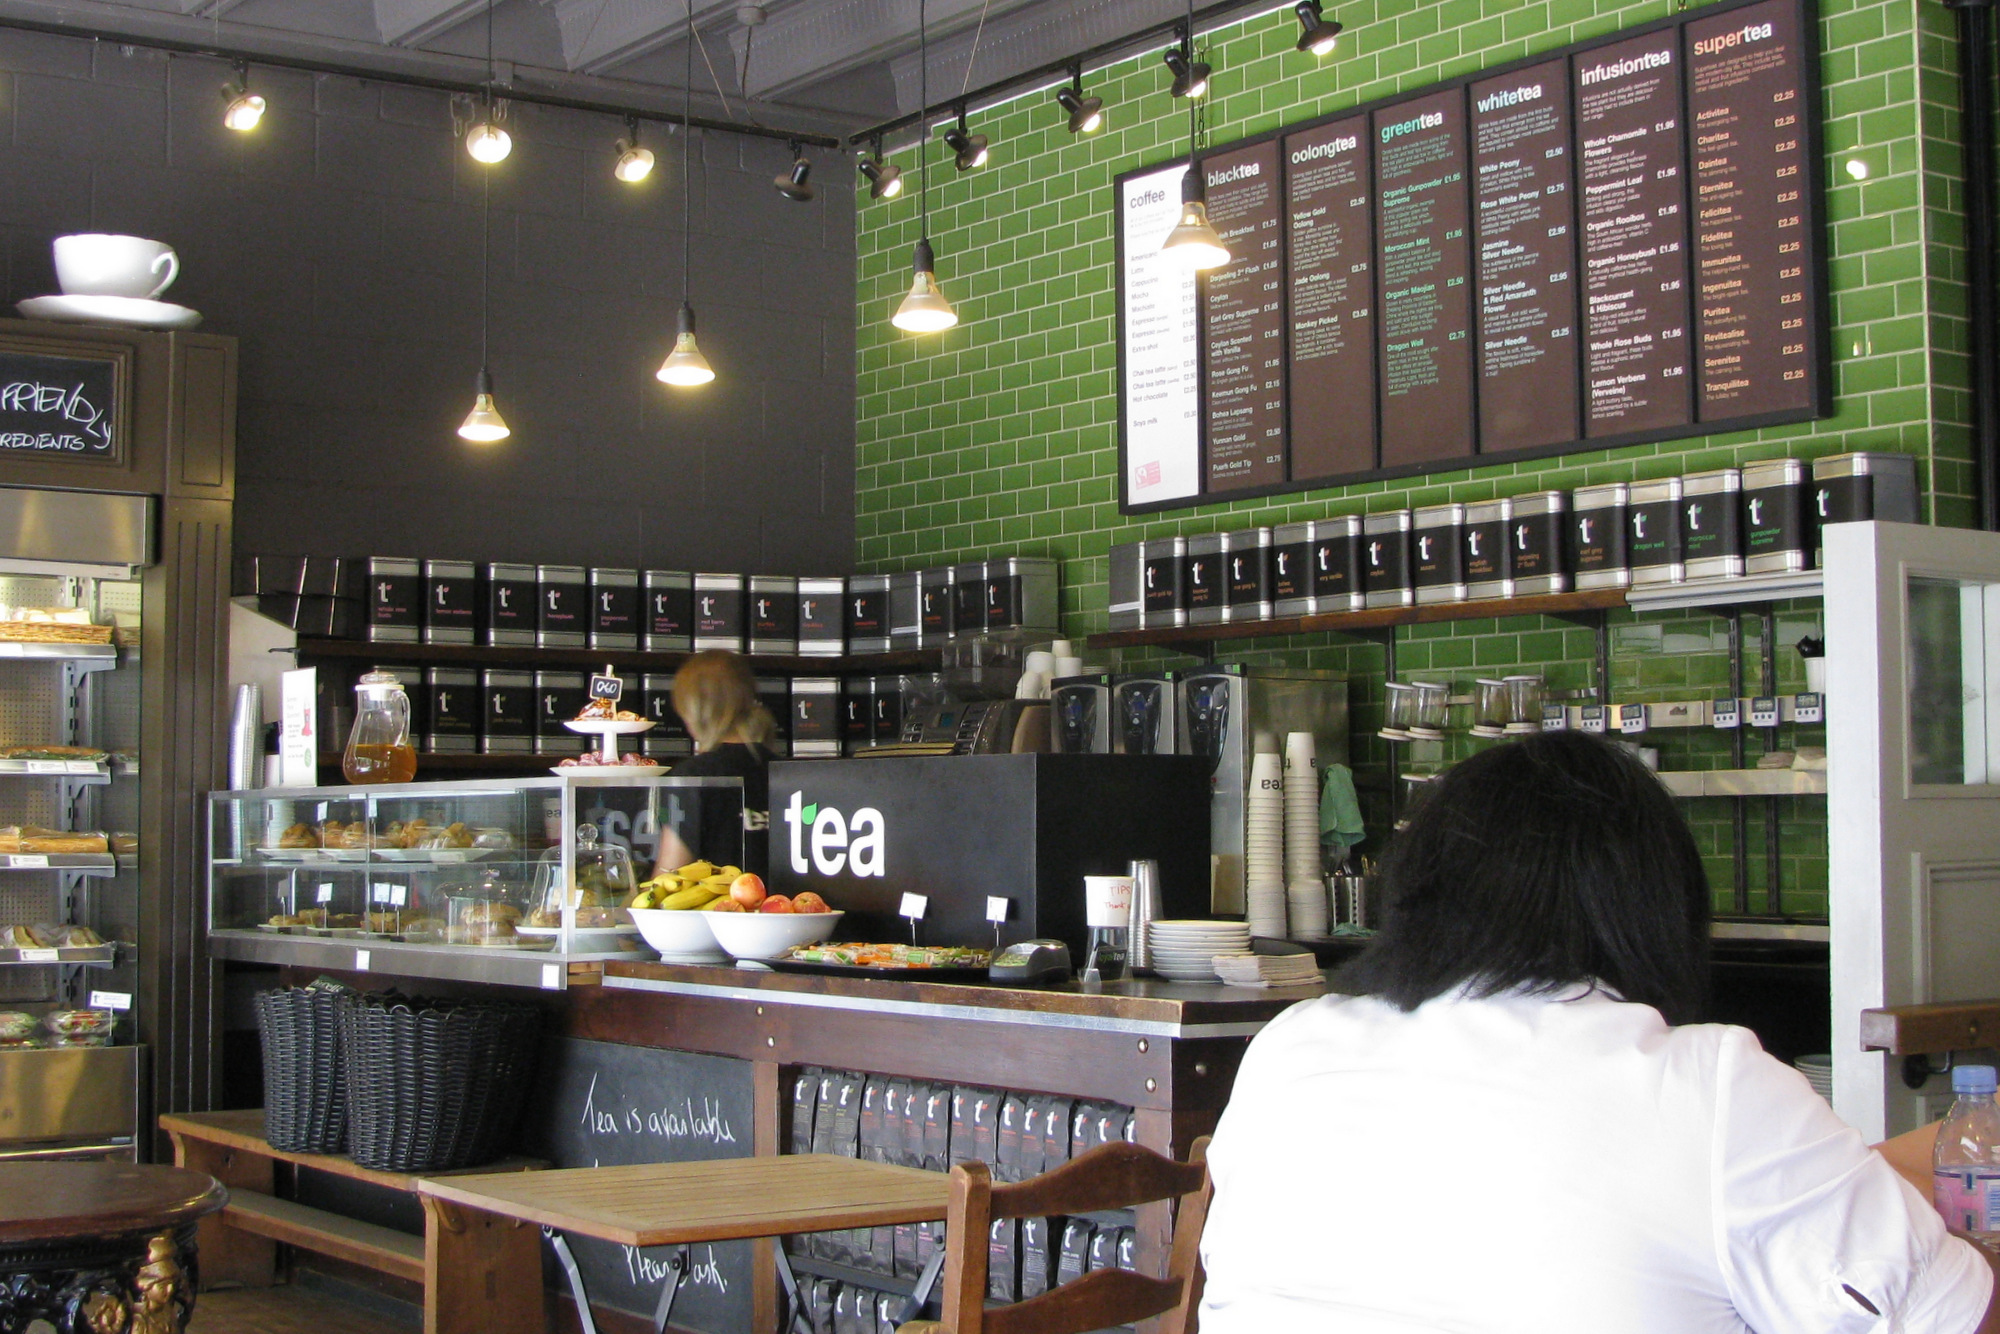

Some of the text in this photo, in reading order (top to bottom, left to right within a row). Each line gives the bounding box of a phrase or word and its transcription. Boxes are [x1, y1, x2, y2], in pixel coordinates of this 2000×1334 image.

[1694, 23, 1772, 56] supertea
[1581, 50, 1670, 86] infusiontea
[1478, 84, 1542, 113] whitetea
[1697, 107, 1729, 121] Activitea
[1381, 112, 1442, 143] greentea
[1584, 138, 1606, 149] Whole
[1698, 132, 1730, 145] Charitea
[1292, 136, 1356, 164] oolongtea
[1480, 164, 1498, 174] White
[1500, 159, 1520, 171] Peony
[1699, 158, 1727, 170] Daintea
[1208, 163, 1260, 187] blacktea
[1586, 179, 1626, 195] Peppermint
[1627, 175, 1643, 184] Leaf
[1700, 181, 1733, 195] Eternitea
[1130, 190, 1165, 209] coffee
[1383, 186, 1406, 199] Organic
[1499, 196, 1517, 205] White
[1700, 206, 1732, 219] Felicitea
[1587, 219, 1614, 232] Organic
[1701, 231, 1733, 243] Fidelitea
[1588, 256, 1616, 268] Organic
[1702, 254, 1742, 268] Immunitea
[1702, 279, 1742, 293] Ingenuitea
[1490, 294, 1503, 303] Red
[1589, 290, 1634, 304] Blackcurrant
[1484, 304, 1506, 314] Flower
[1703, 306, 1731, 318] Puritea
[1485, 340, 1503, 350] Silver
[1504, 336, 1527, 346] Needle
[1591, 339, 1612, 350] Whole
[1614, 337, 1632, 347] Rose
[1634, 333, 1652, 344] Buds
[1705, 356, 1741, 367] Serenitea
[1592, 378, 1616, 388] Lemon
[1617, 373, 1646, 384] Verbena
[784, 790, 885, 878] tea
[582, 1072, 618, 1134] Tea
[623, 1094, 642, 1134] is
